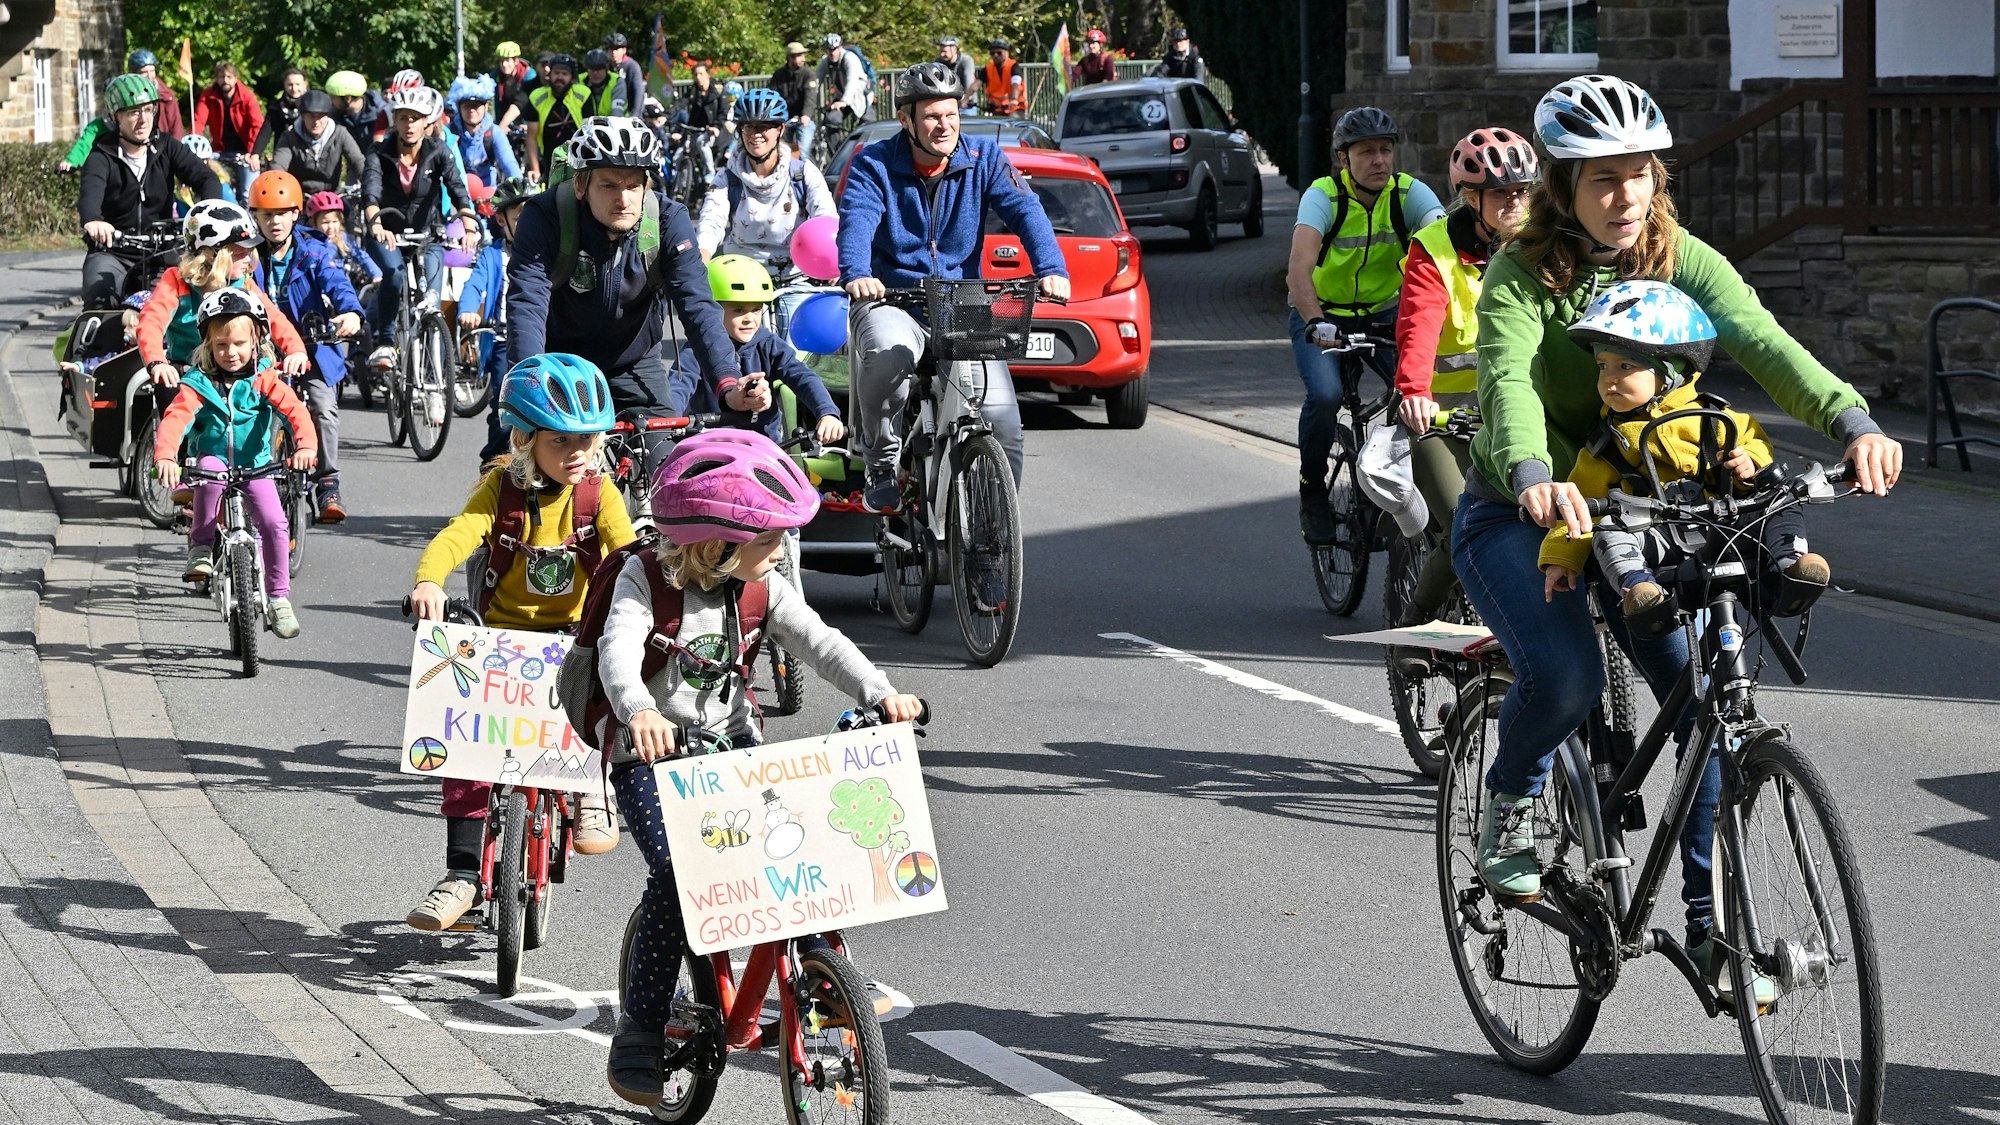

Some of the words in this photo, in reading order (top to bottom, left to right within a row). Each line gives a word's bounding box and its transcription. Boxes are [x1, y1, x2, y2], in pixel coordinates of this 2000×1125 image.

[997, 248, 1015, 257] KIA
[545, 577, 571, 594] FUTURE
[483, 668, 535, 707] FÜR
[444, 707, 586, 754] KINDER
[735, 751, 831, 788] WOLLEN
[843, 742, 903, 770] AUCH
[687, 876, 758, 911] WENN
[699, 907, 782, 945] GROSS
